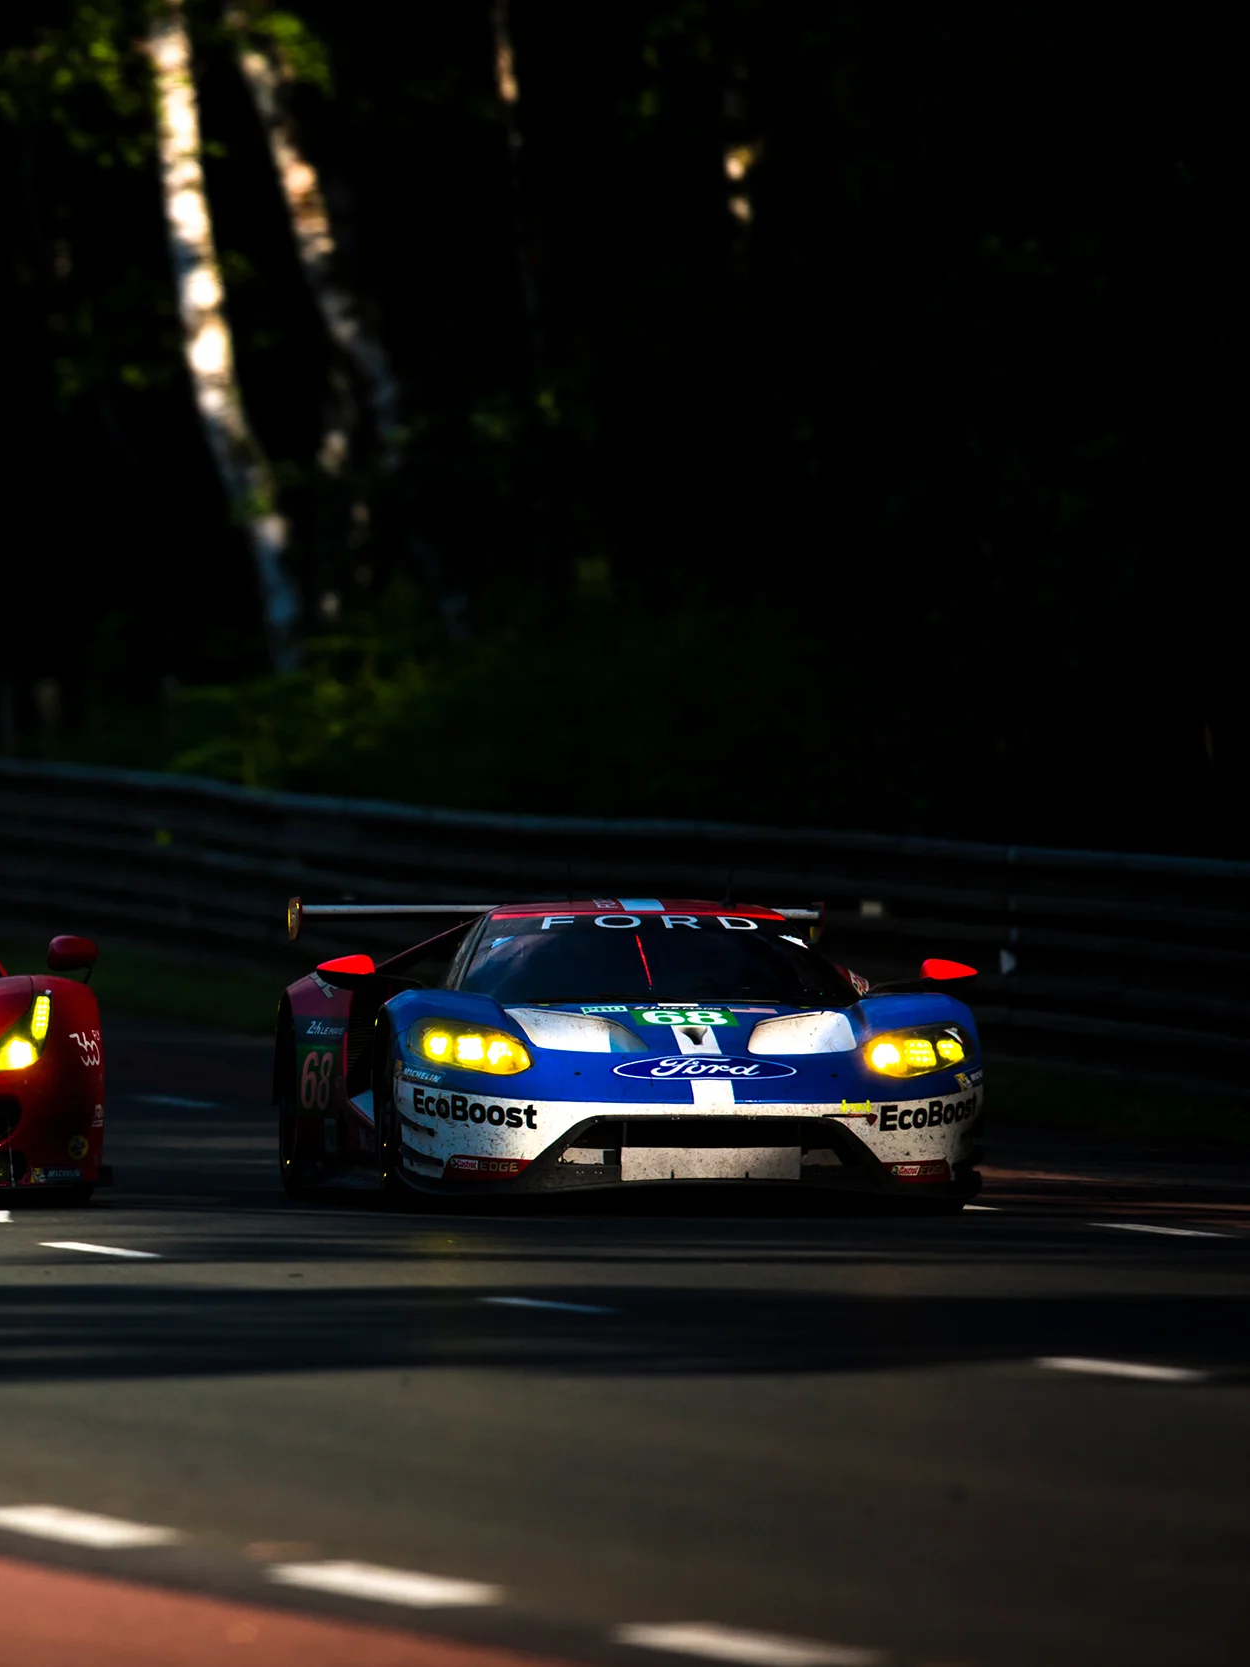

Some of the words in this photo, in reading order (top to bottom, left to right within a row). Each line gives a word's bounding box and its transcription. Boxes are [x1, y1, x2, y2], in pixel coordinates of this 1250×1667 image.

[541, 915, 758, 930] FORD
[642, 1011, 728, 1025] 68
[403, 1067, 442, 1083] MICHELIN
[650, 1057, 762, 1077] Ford
[301, 1051, 334, 1111] 68
[413, 1088, 537, 1130] EcoBoost
[880, 1092, 977, 1131] EcoBoost
[479, 1162, 519, 1172] EDGE
[919, 1165, 947, 1175] EDGE
